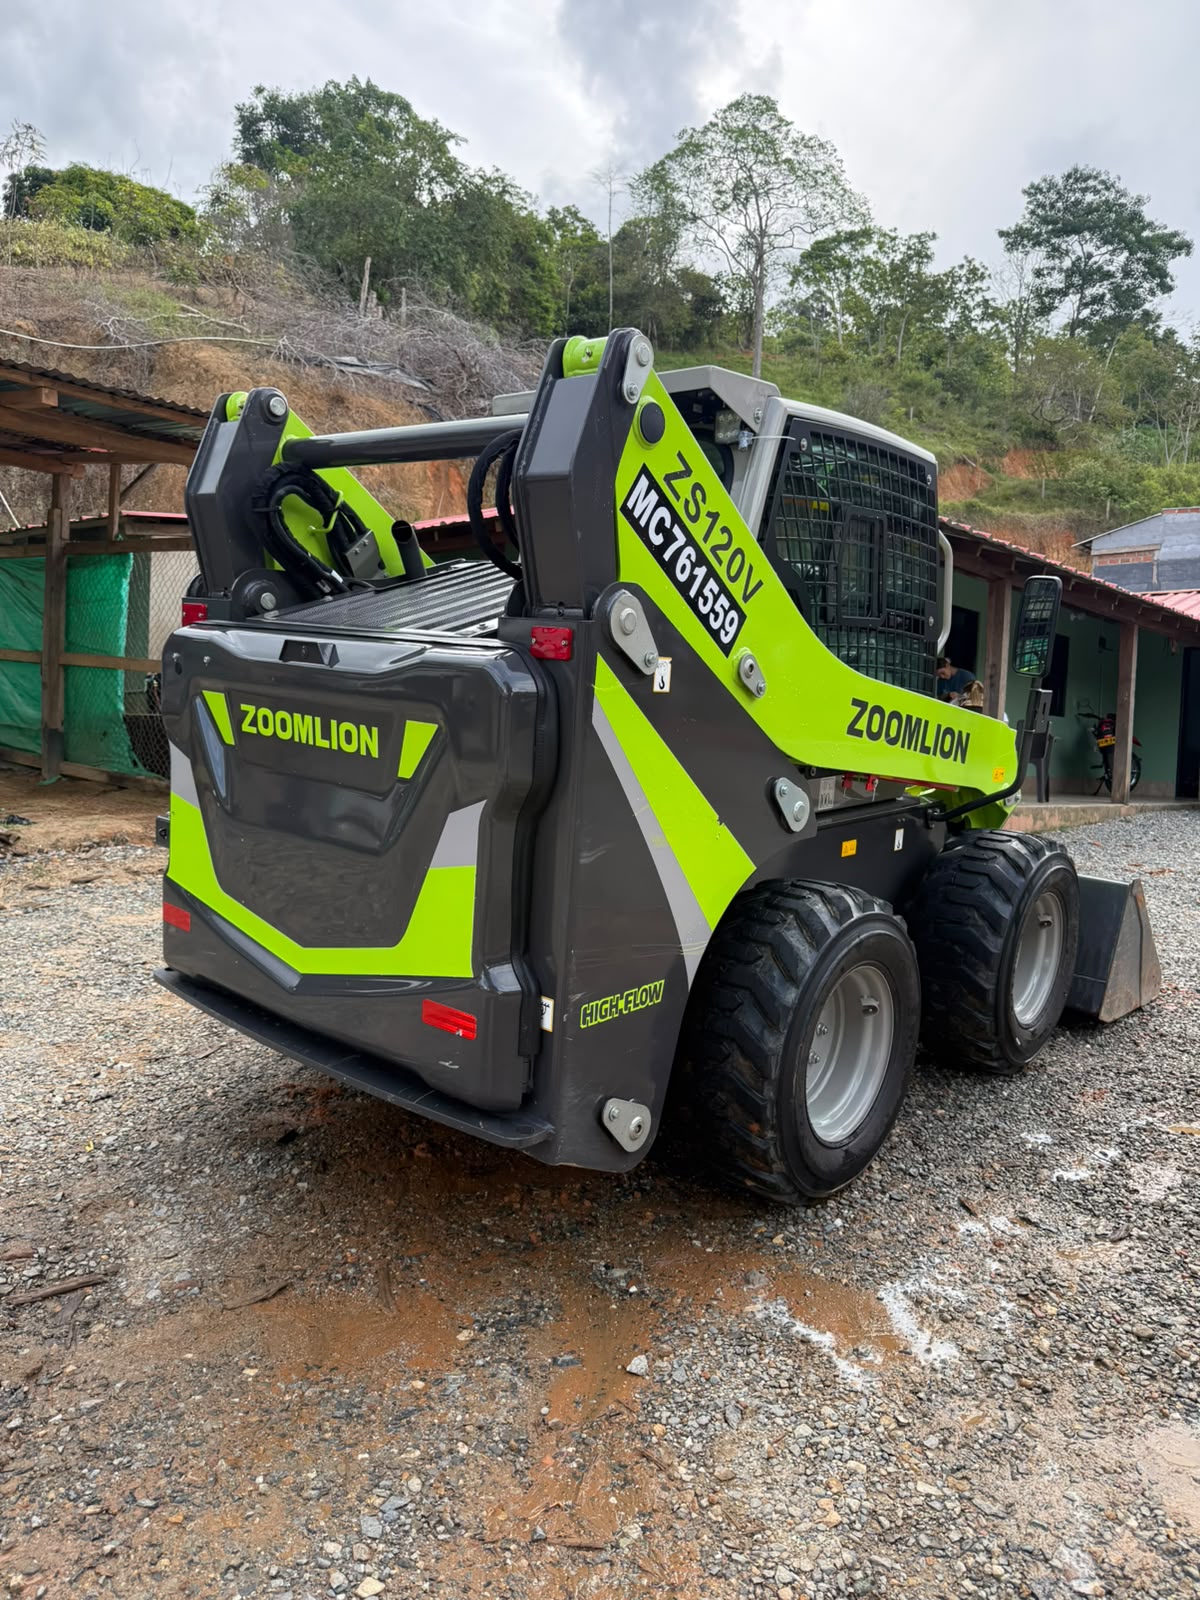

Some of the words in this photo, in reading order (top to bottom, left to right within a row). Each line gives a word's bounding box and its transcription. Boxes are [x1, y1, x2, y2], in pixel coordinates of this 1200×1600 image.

[626, 473, 739, 644] MC761559
[663, 450, 764, 604] ZS120V
[240, 703, 379, 759] ZOOMLION
[846, 697, 971, 765] ZOOMLION
[580, 979, 665, 1029] HIGH-FLOW
